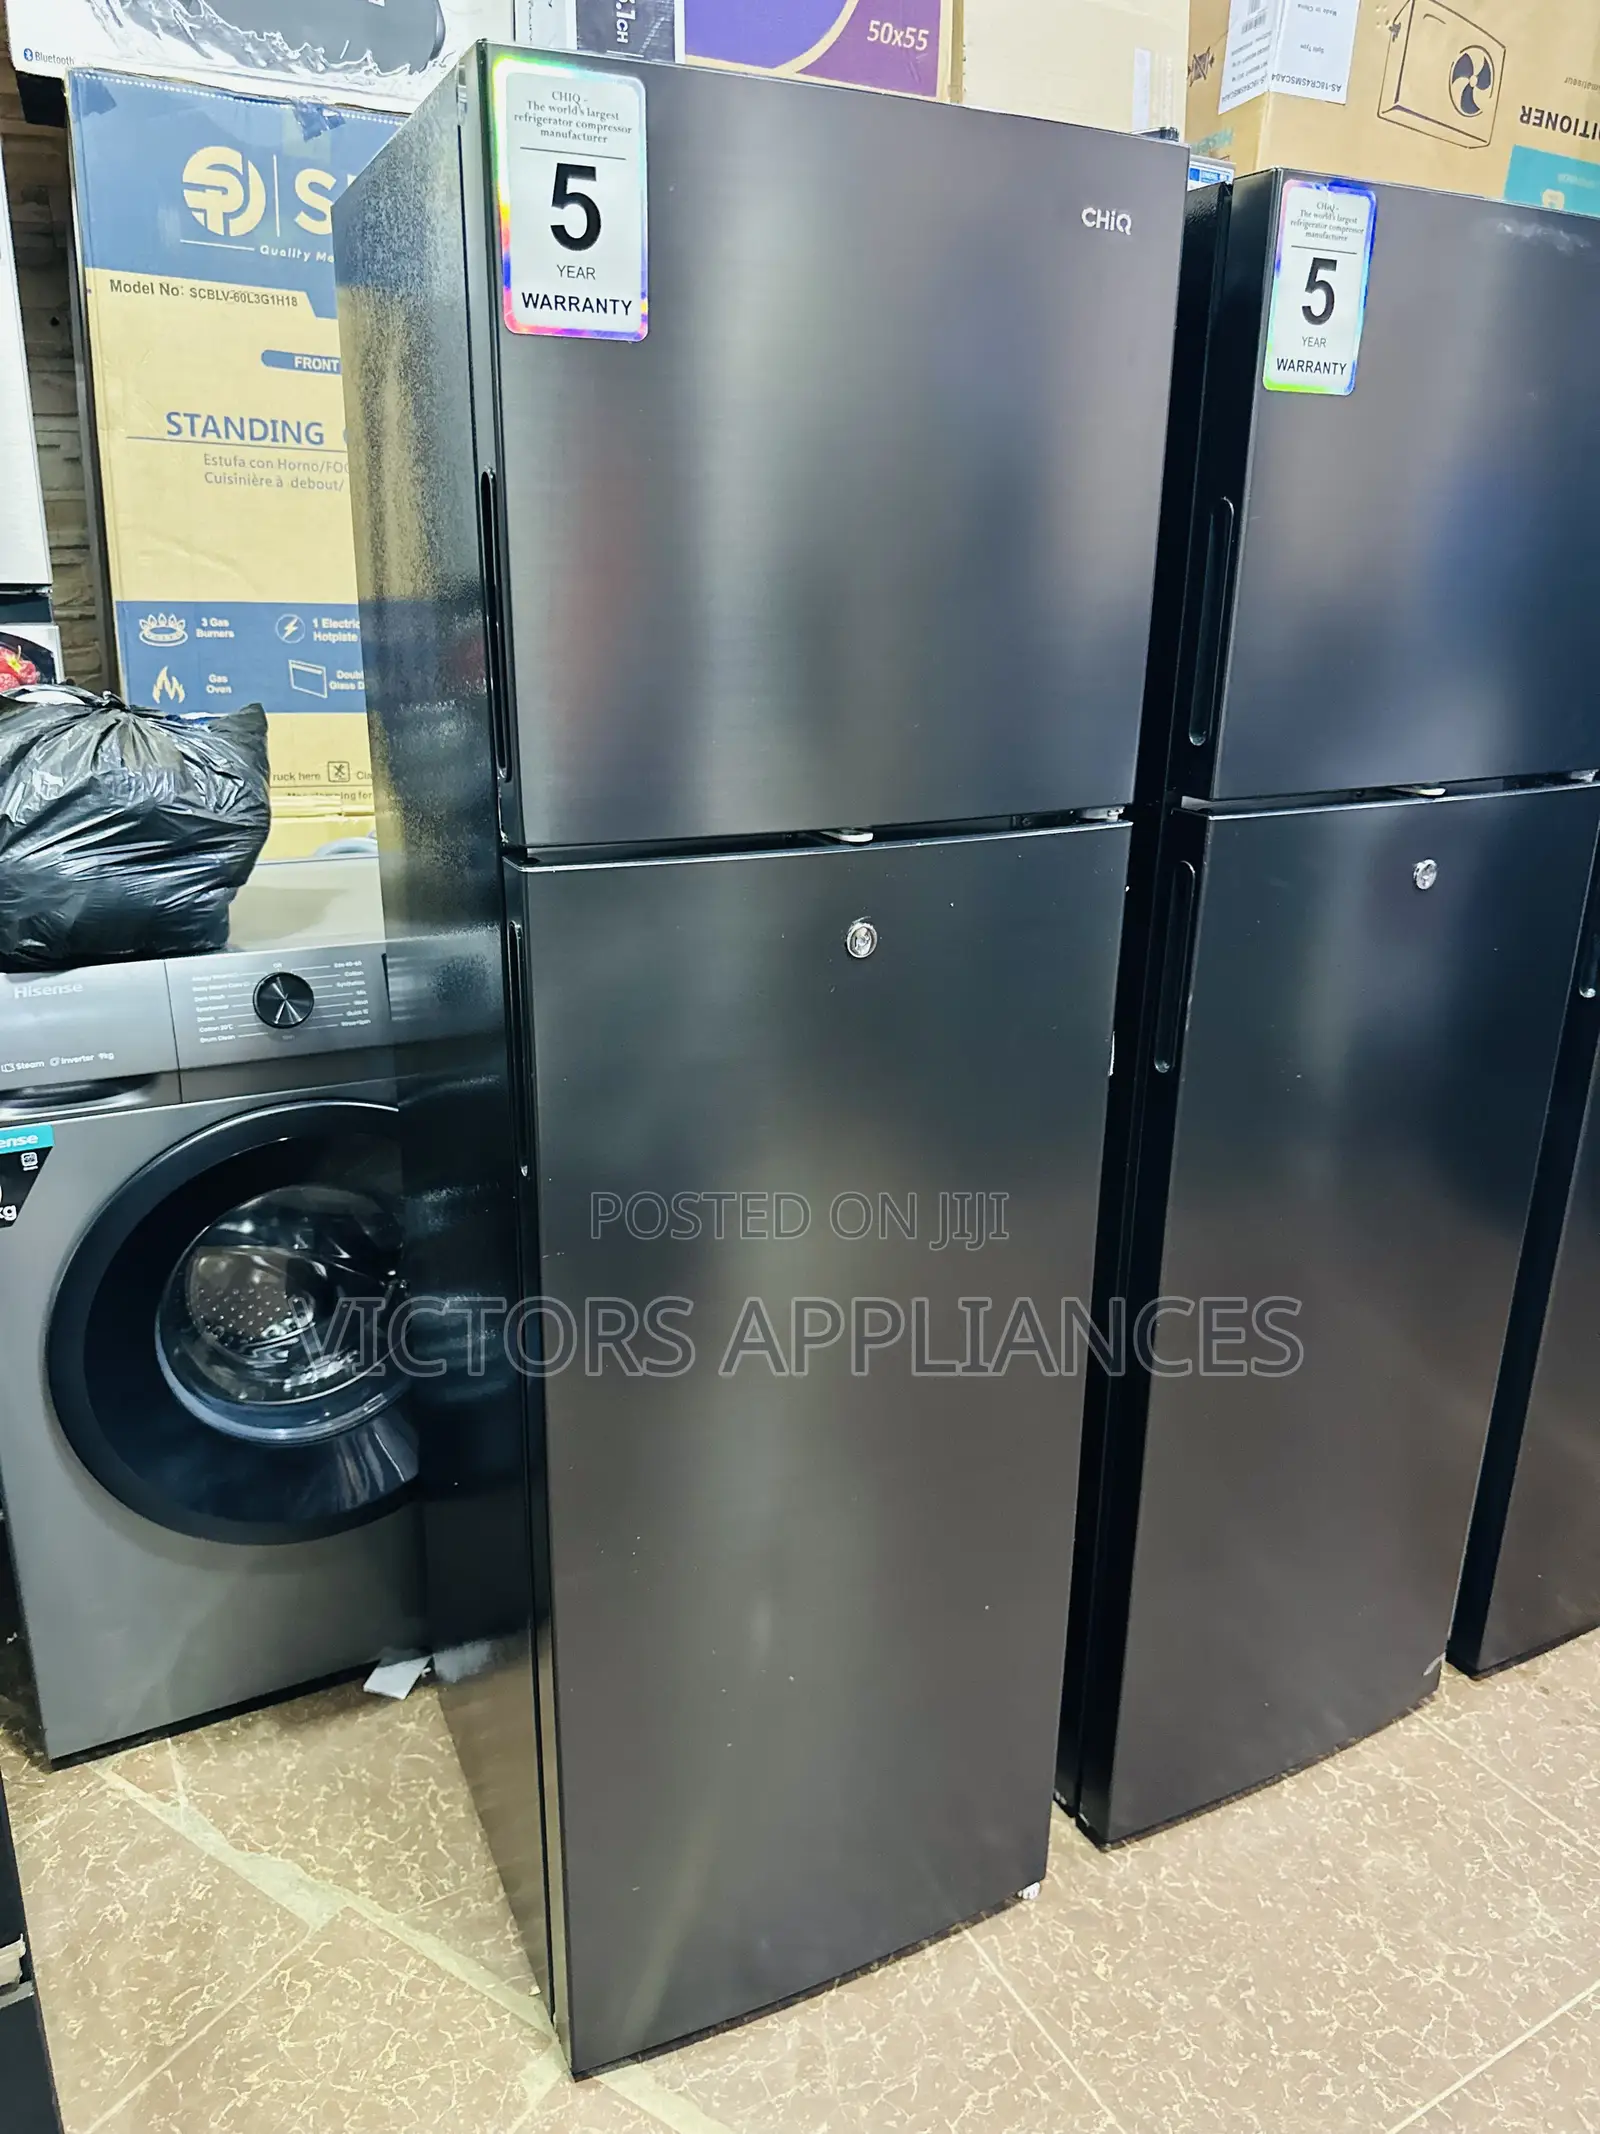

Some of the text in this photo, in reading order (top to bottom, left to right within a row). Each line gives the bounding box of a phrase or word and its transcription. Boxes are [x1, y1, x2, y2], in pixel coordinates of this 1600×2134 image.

[867, 20, 929, 51] 50x55
[35, 52, 74, 66] Bluetooth
[526, 101, 546, 111] The
[587, 108, 619, 121] largest
[514, 113, 632, 134] refrigerator compressor
[540, 129, 607, 143] manufacturer
[550, 163, 601, 251] 5
[260, 245, 310, 263] Quality
[557, 264, 596, 280] YEAR
[110, 279, 155, 295] Model
[159, 283, 184, 297] No:
[1302, 257, 1337, 325] 5
[522, 292, 632, 316] WARRANTY
[1302, 336, 1327, 348] YEAR
[294, 355, 339, 372] FRONT
[1276, 358, 1347, 375] WARRANTY
[165, 411, 325, 446] STANDING
[204, 453, 246, 468] Estufa
[250, 458, 274, 470] con
[204, 472, 273, 487] Cuisinière
[201, 617, 230, 627] 3 Gas
[313, 618, 318, 628] 1
[196, 628, 235, 638] Burners
[313, 632, 358, 643] Hotplate
[208, 674, 228, 683] Gas
[206, 684, 232, 694] Oven
[14, 983, 83, 998] Hisense
[16, 1060, 45, 1071] Steam
